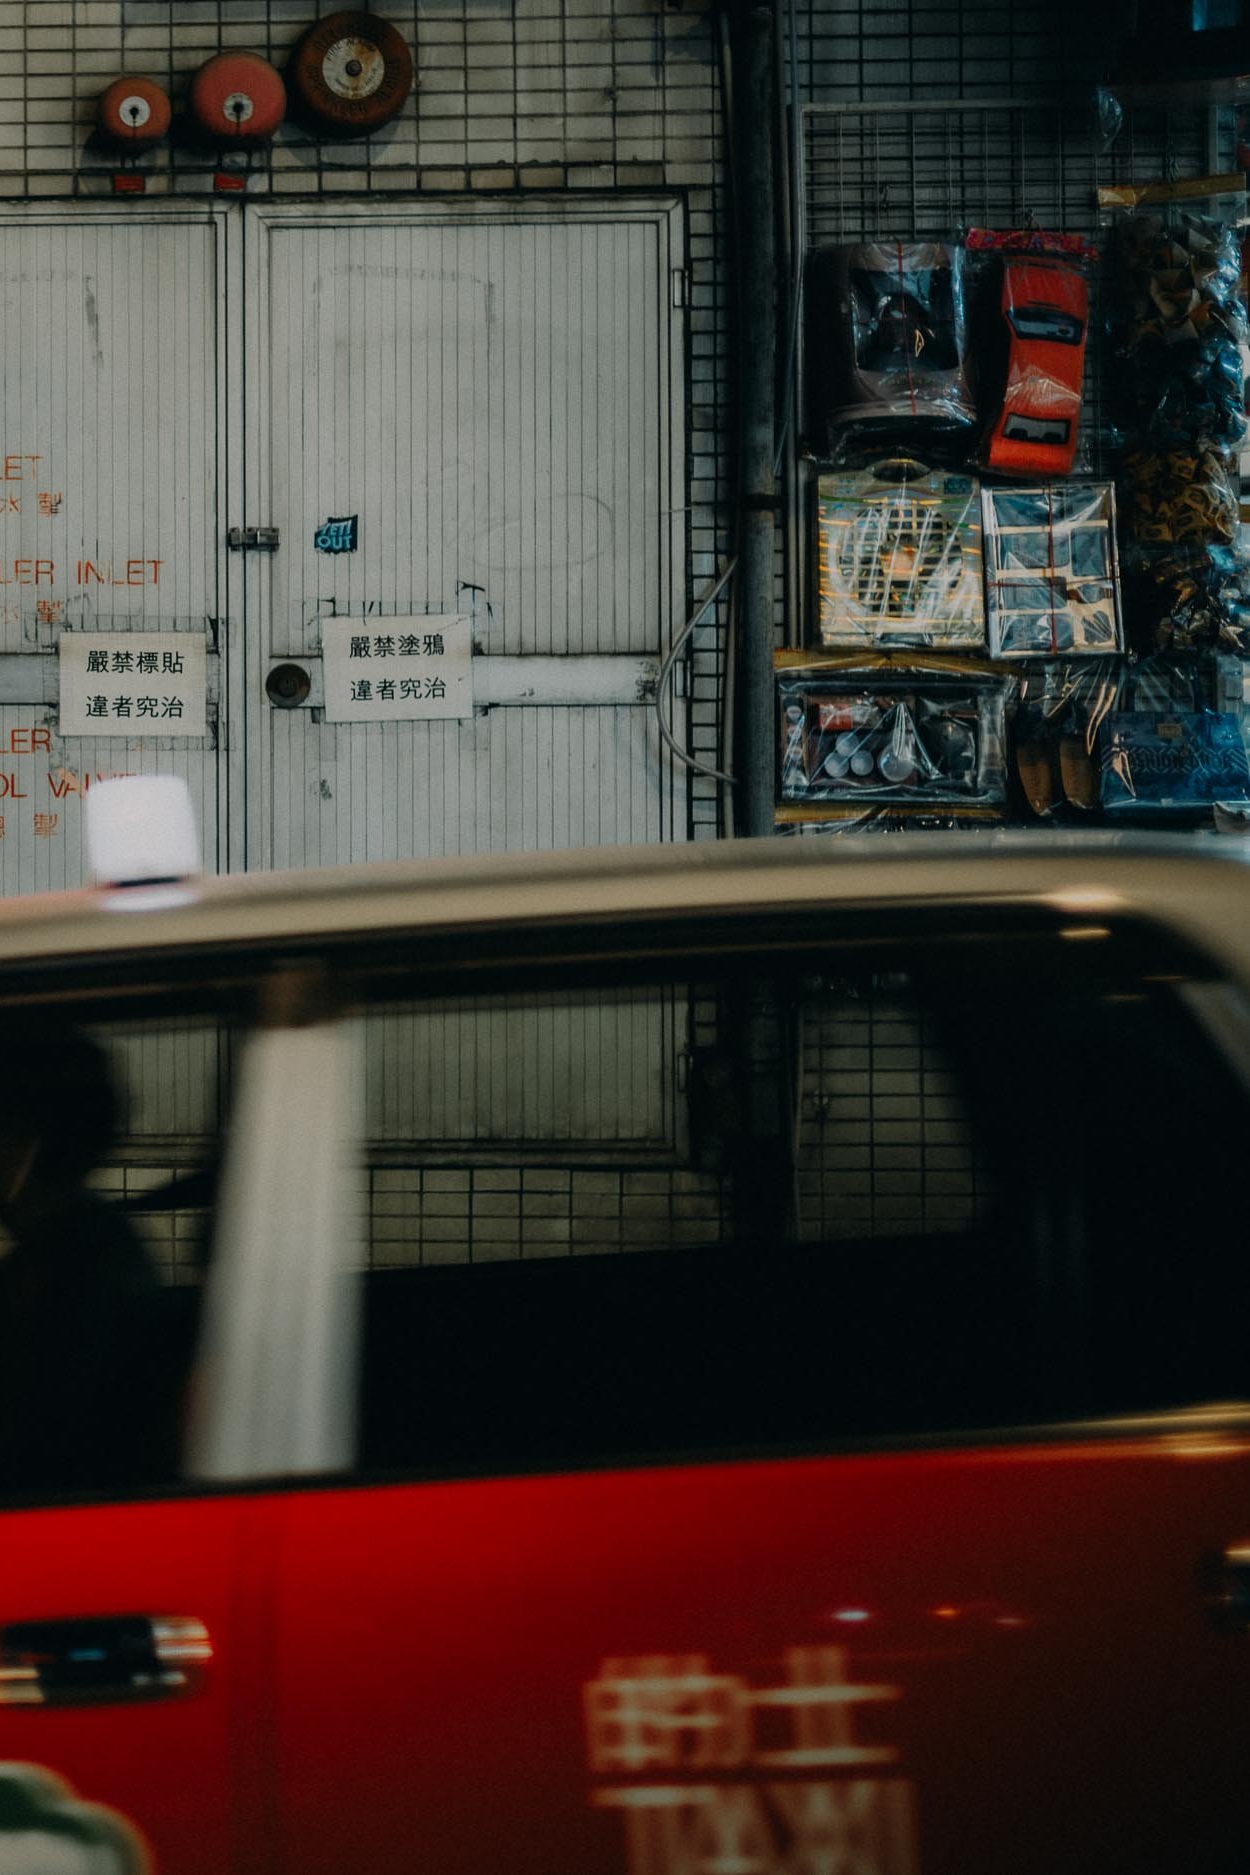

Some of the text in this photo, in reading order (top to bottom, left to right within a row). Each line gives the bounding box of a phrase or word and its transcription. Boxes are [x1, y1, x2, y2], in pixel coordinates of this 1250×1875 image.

[317, 534, 353, 550] OUT
[77, 559, 166, 586] INLET
[349, 633, 445, 659] 嚴禁塗鴉
[86, 650, 185, 675] 嚴禁標貼
[349, 677, 447, 703] 違者究治
[85, 694, 185, 719] 違者究治
